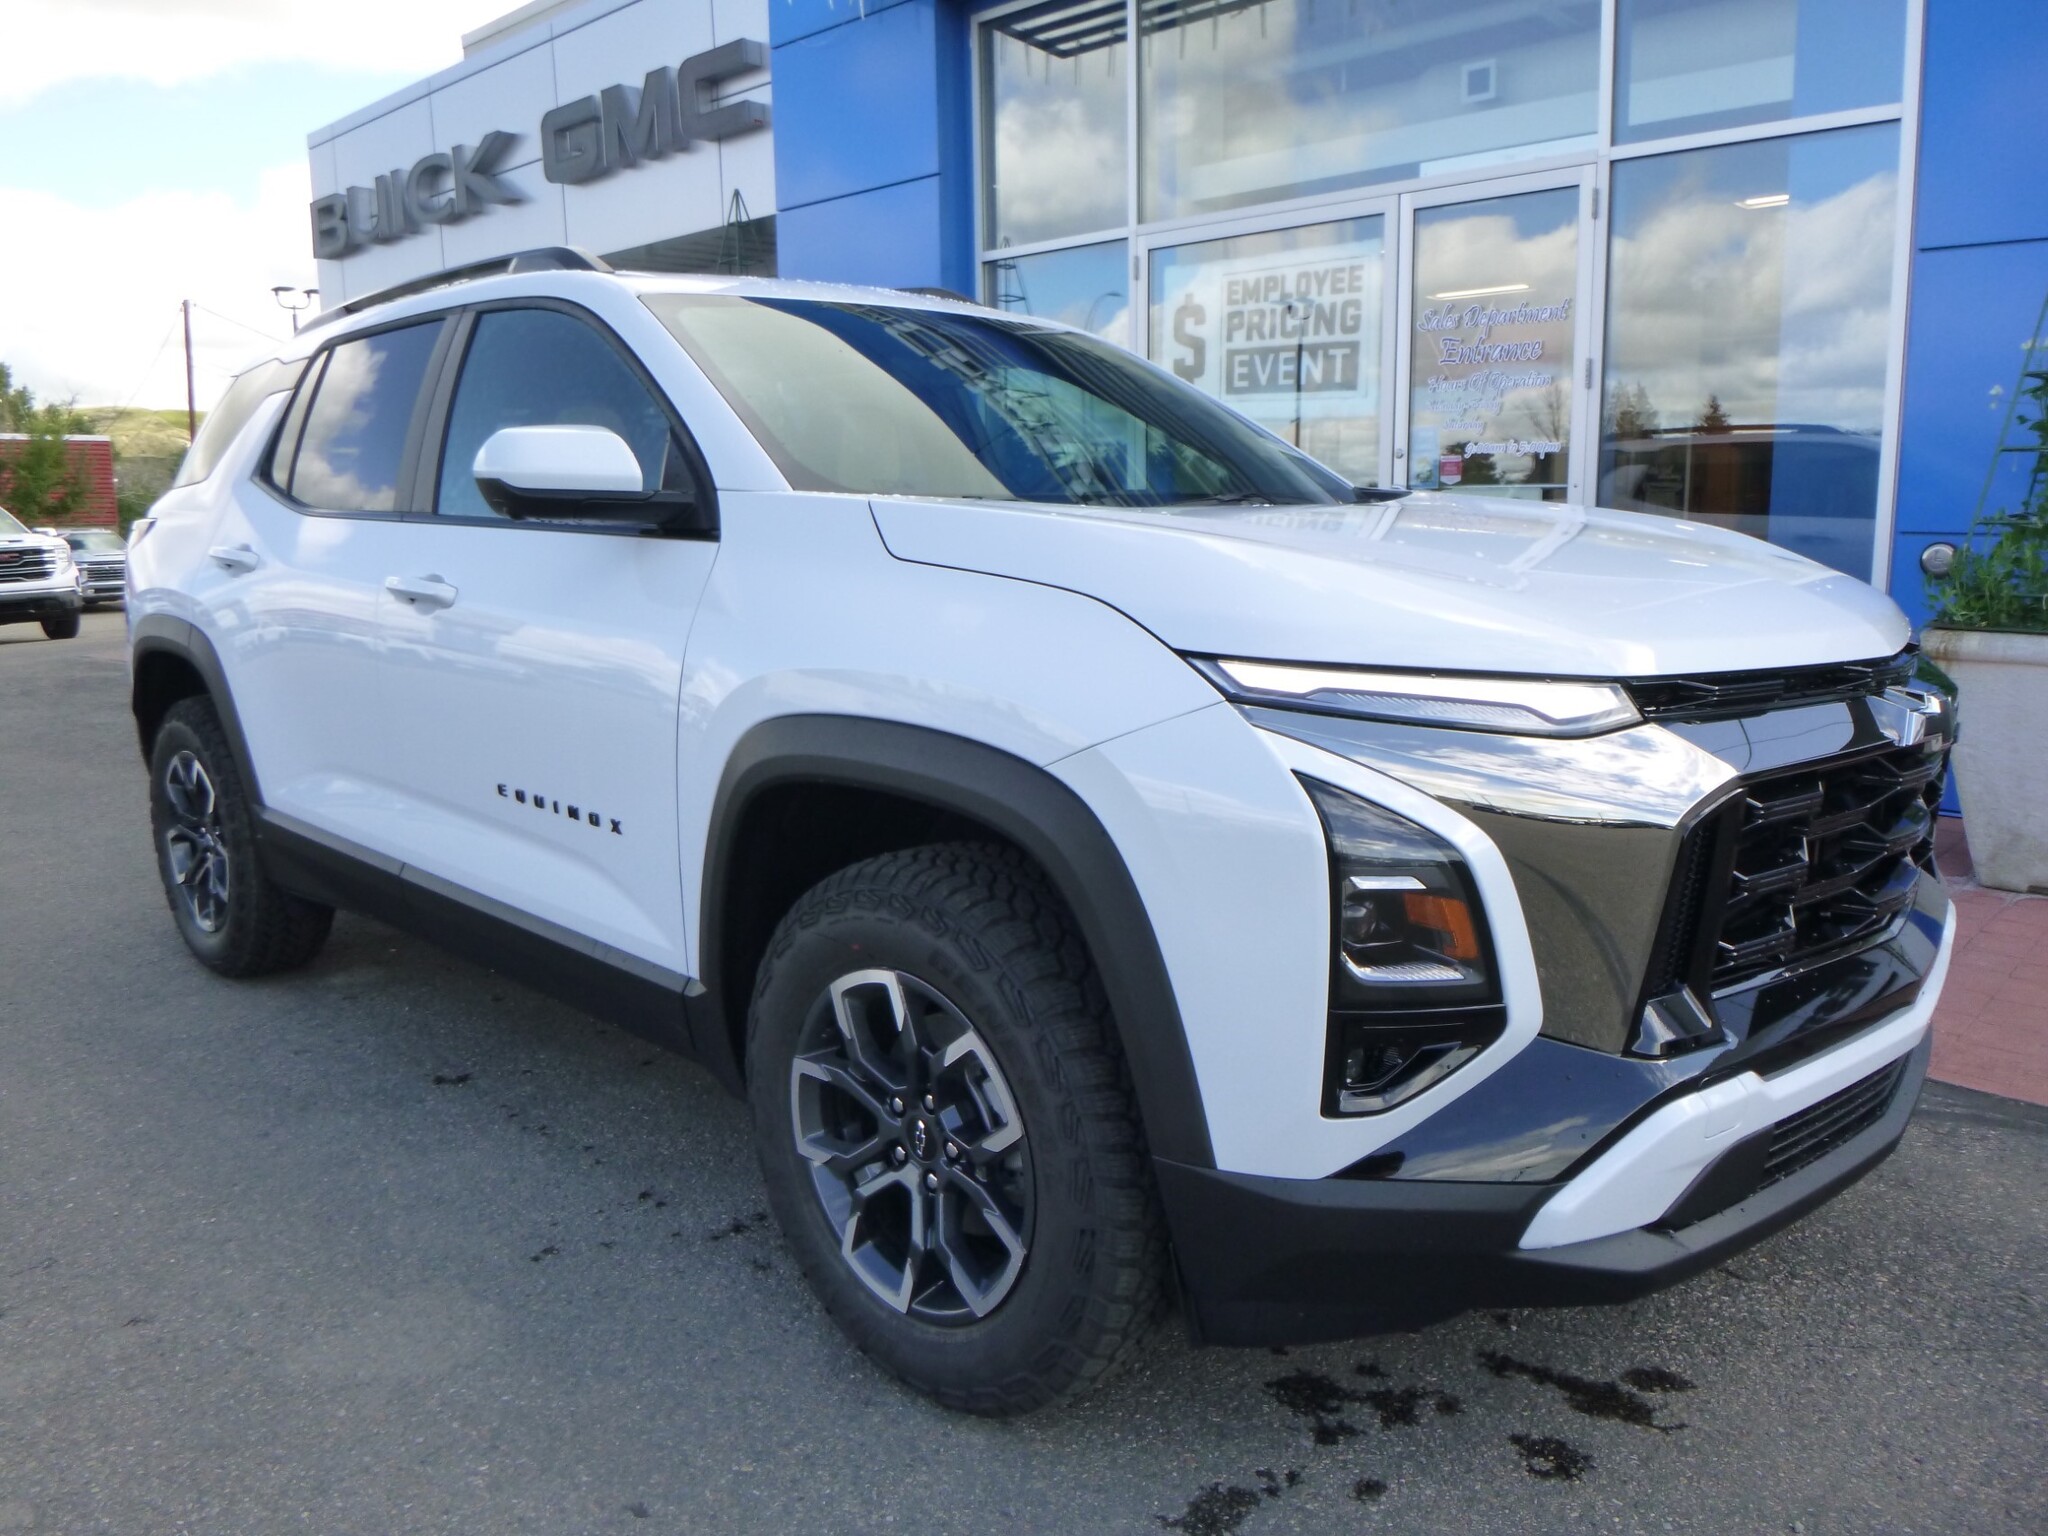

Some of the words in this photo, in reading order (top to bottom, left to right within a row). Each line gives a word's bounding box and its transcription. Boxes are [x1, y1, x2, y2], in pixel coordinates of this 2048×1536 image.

[310, 130, 526, 259] BUICK
[541, 38, 770, 184] GMC
[1226, 264, 1365, 306] EMPLOYEE
[1173, 292, 1207, 384] $
[1226, 298, 1362, 343] PRICING
[1416, 303, 1462, 332] Sales
[1464, 298, 1572, 338] Department
[1232, 348, 1351, 388] EVENT
[1438, 335, 1546, 364] Entrance
[1428, 374, 1466, 393] Hours
[1489, 369, 1552, 398] Operation
[497, 783, 622, 835] EQUINOX
